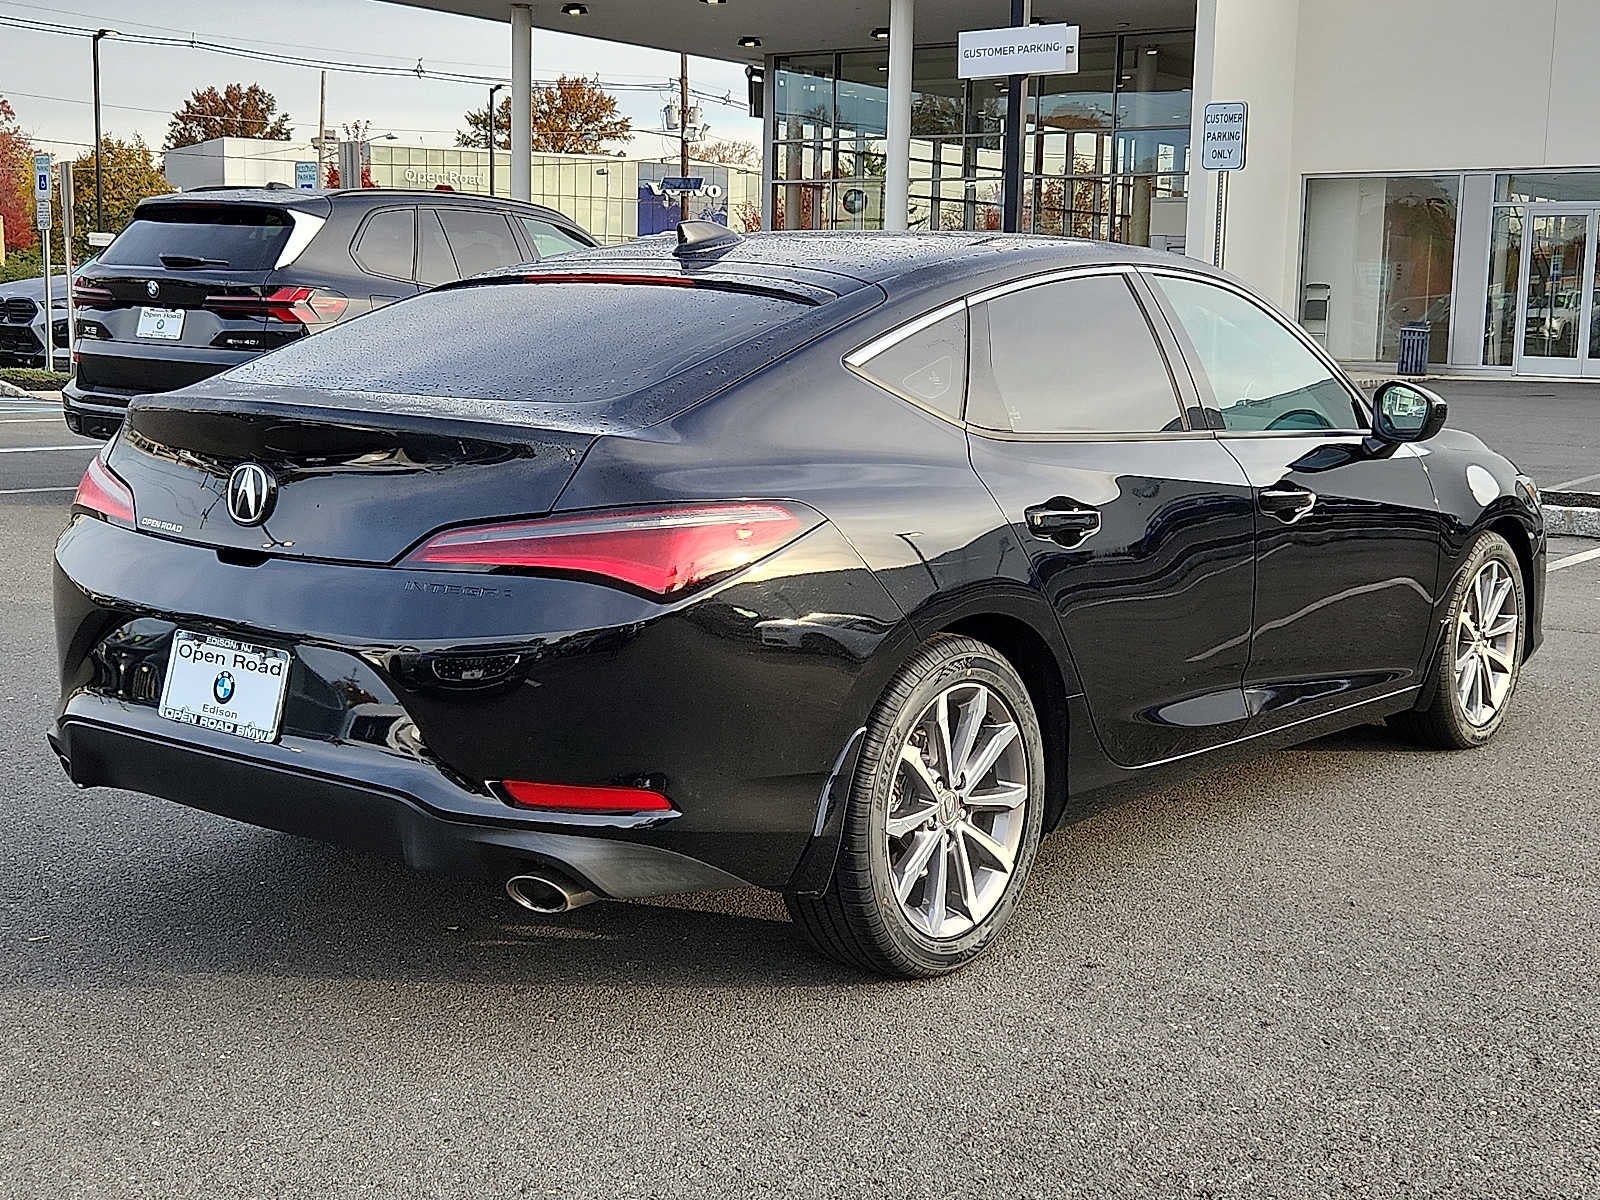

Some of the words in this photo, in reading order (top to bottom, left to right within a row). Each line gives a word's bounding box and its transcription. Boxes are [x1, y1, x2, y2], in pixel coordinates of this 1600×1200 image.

[963, 46, 1015, 59] CUSTOMER
[1017, 41, 1060, 55] PARKING
[1206, 113, 1243, 124] CUSTOMER
[1206, 131, 1241, 142] PARKING
[1211, 149, 1233, 160] ONLY
[404, 168, 448, 184] Open
[448, 170, 485, 185] Road
[141, 517, 161, 528] OPEN
[160, 521, 183, 533] ROAD
[240, 643, 253, 652] NJ
[179, 643, 226, 666] Open
[232, 653, 283, 677] Road
[202, 703, 239, 720] Edison
[164, 707, 198, 724] OPEN
[200, 717, 235, 734] ROAD
[235, 725, 268, 741] BMW
